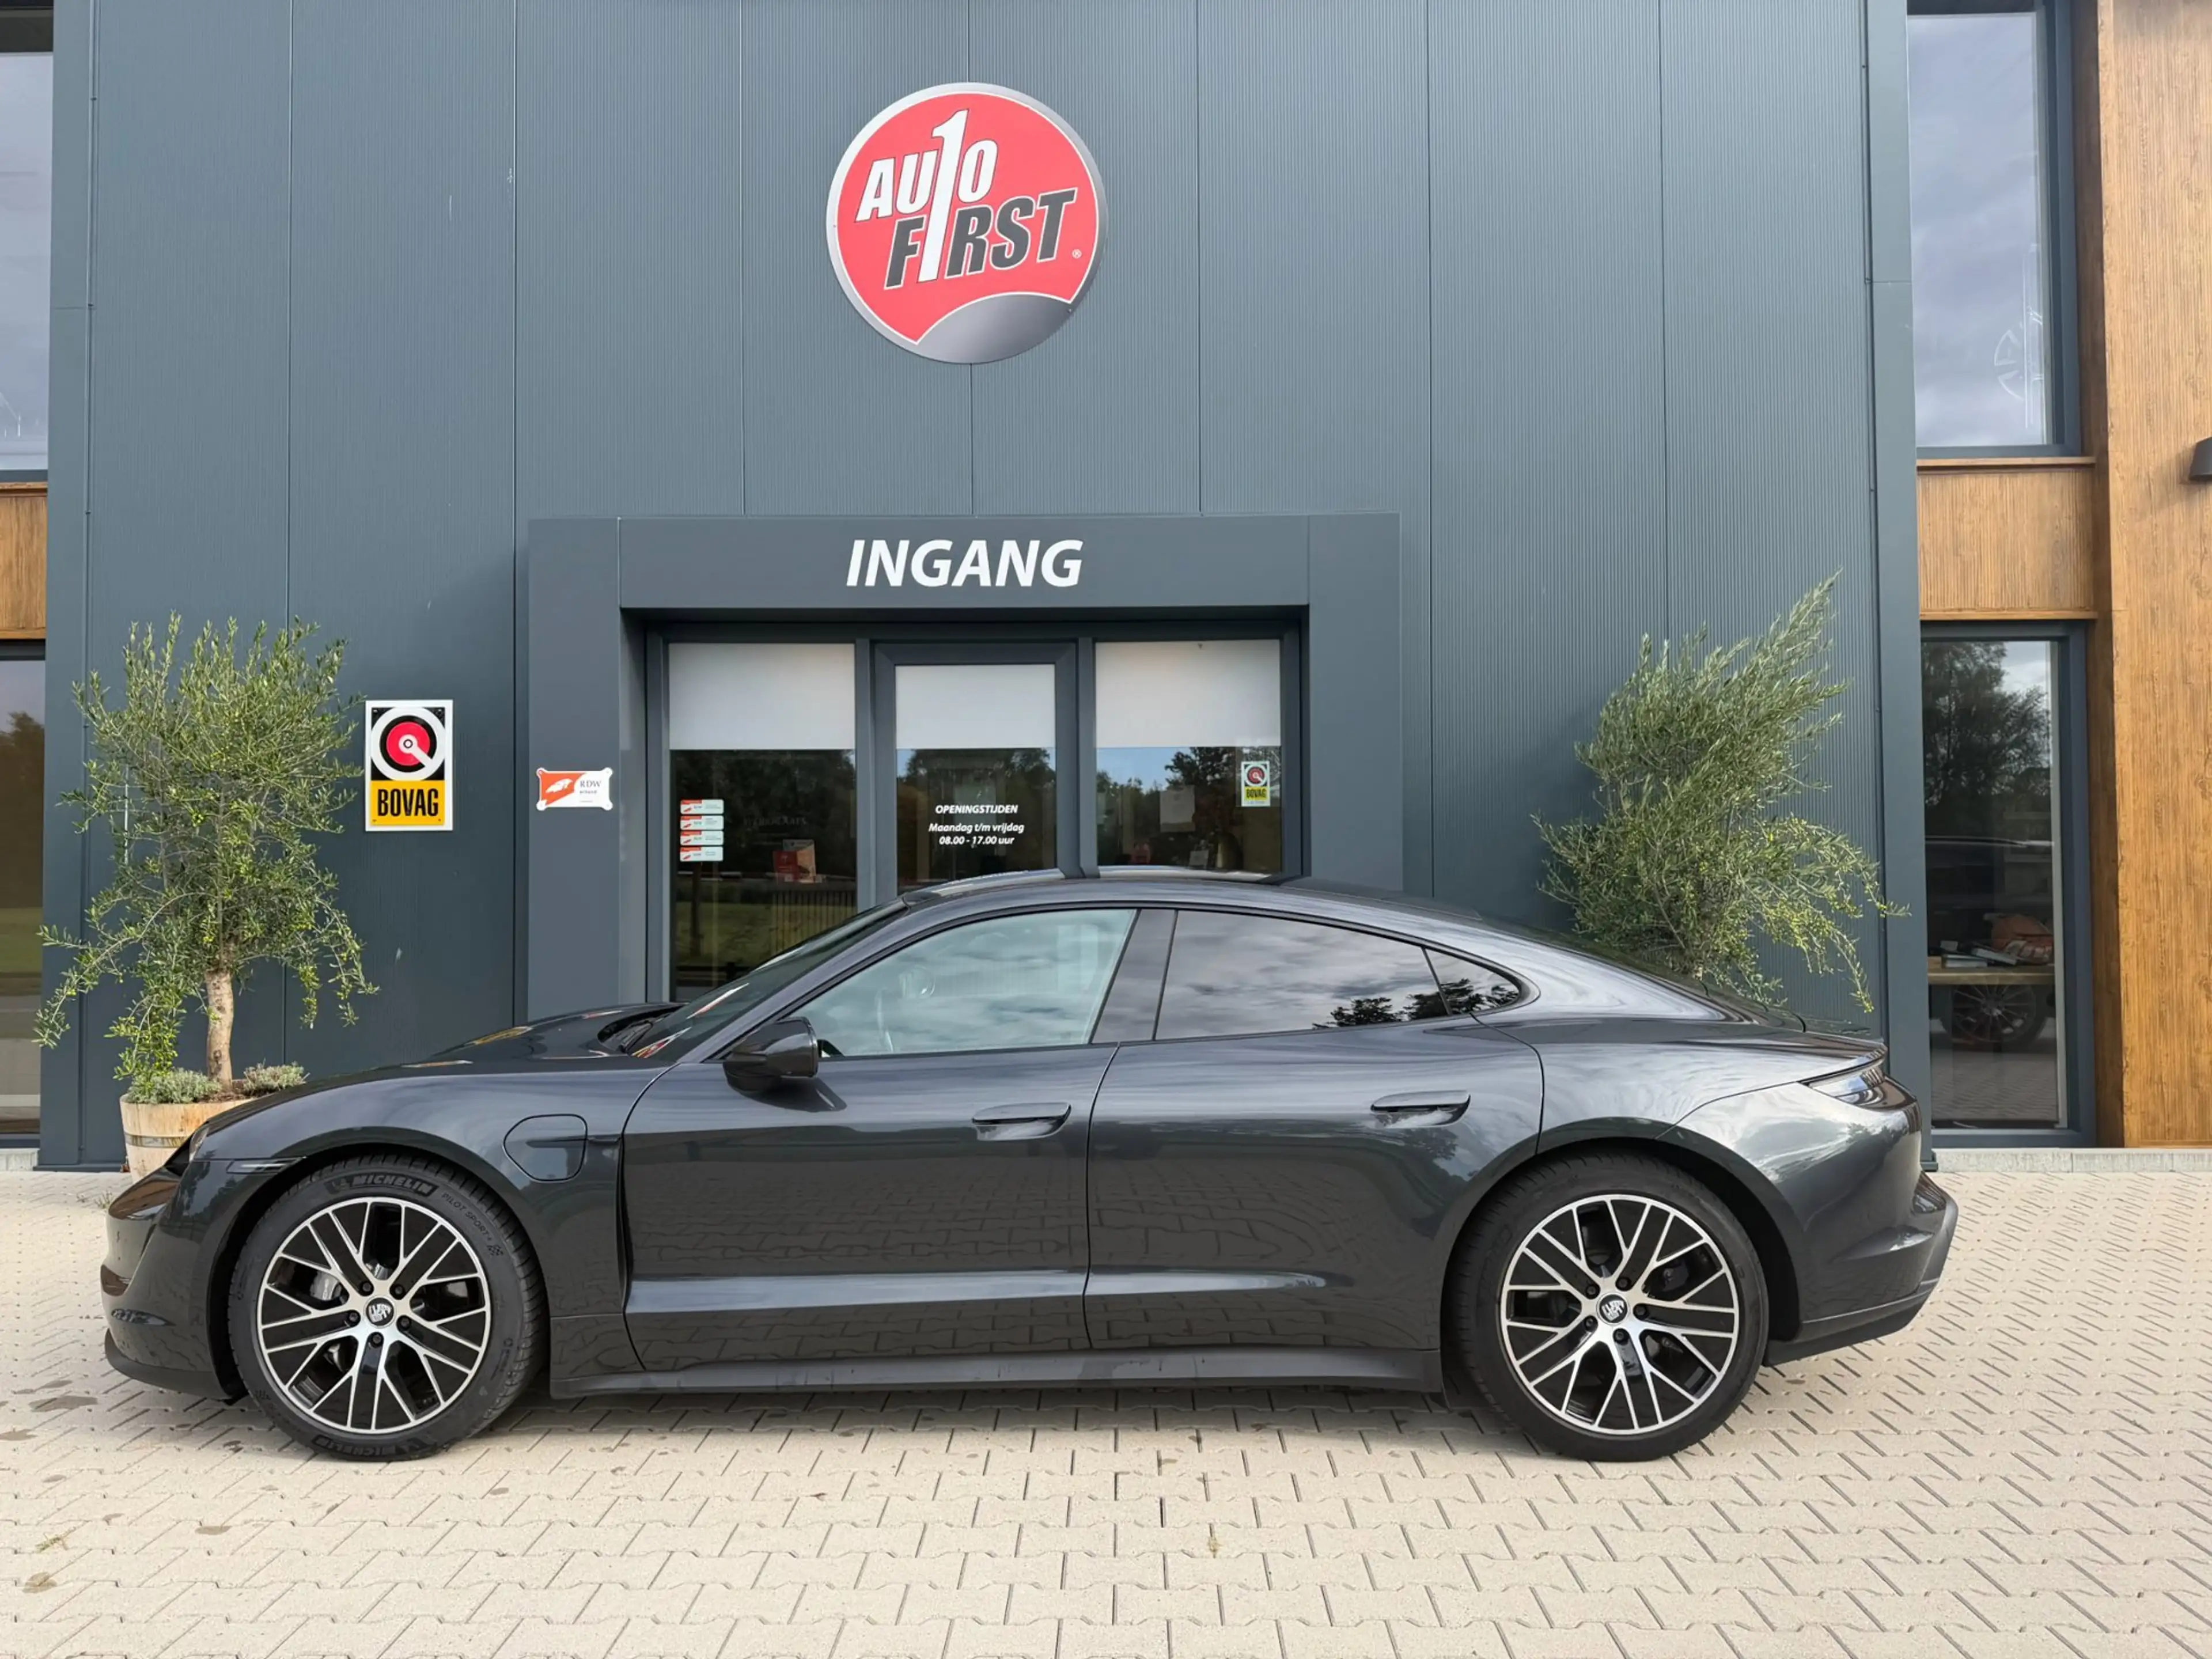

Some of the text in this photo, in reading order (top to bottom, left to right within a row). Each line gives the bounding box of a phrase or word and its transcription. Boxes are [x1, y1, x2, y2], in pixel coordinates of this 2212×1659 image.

[846, 539, 1084, 588] INGANG
[579, 780, 601, 788] RDW
[1246, 788, 1267, 798] BOVAG
[378, 788, 439, 817] BOVAG
[935, 805, 1018, 815] OPENINGSTIJDEN
[928, 823, 1025, 834] Maandag t/m vrijdag
[939, 836, 965, 845] 08.00
[972, 836, 997, 845] 17.00
[352, 1174, 434, 1194] MICHELIN
[442, 1192, 489, 1236] PILOT SPORT
